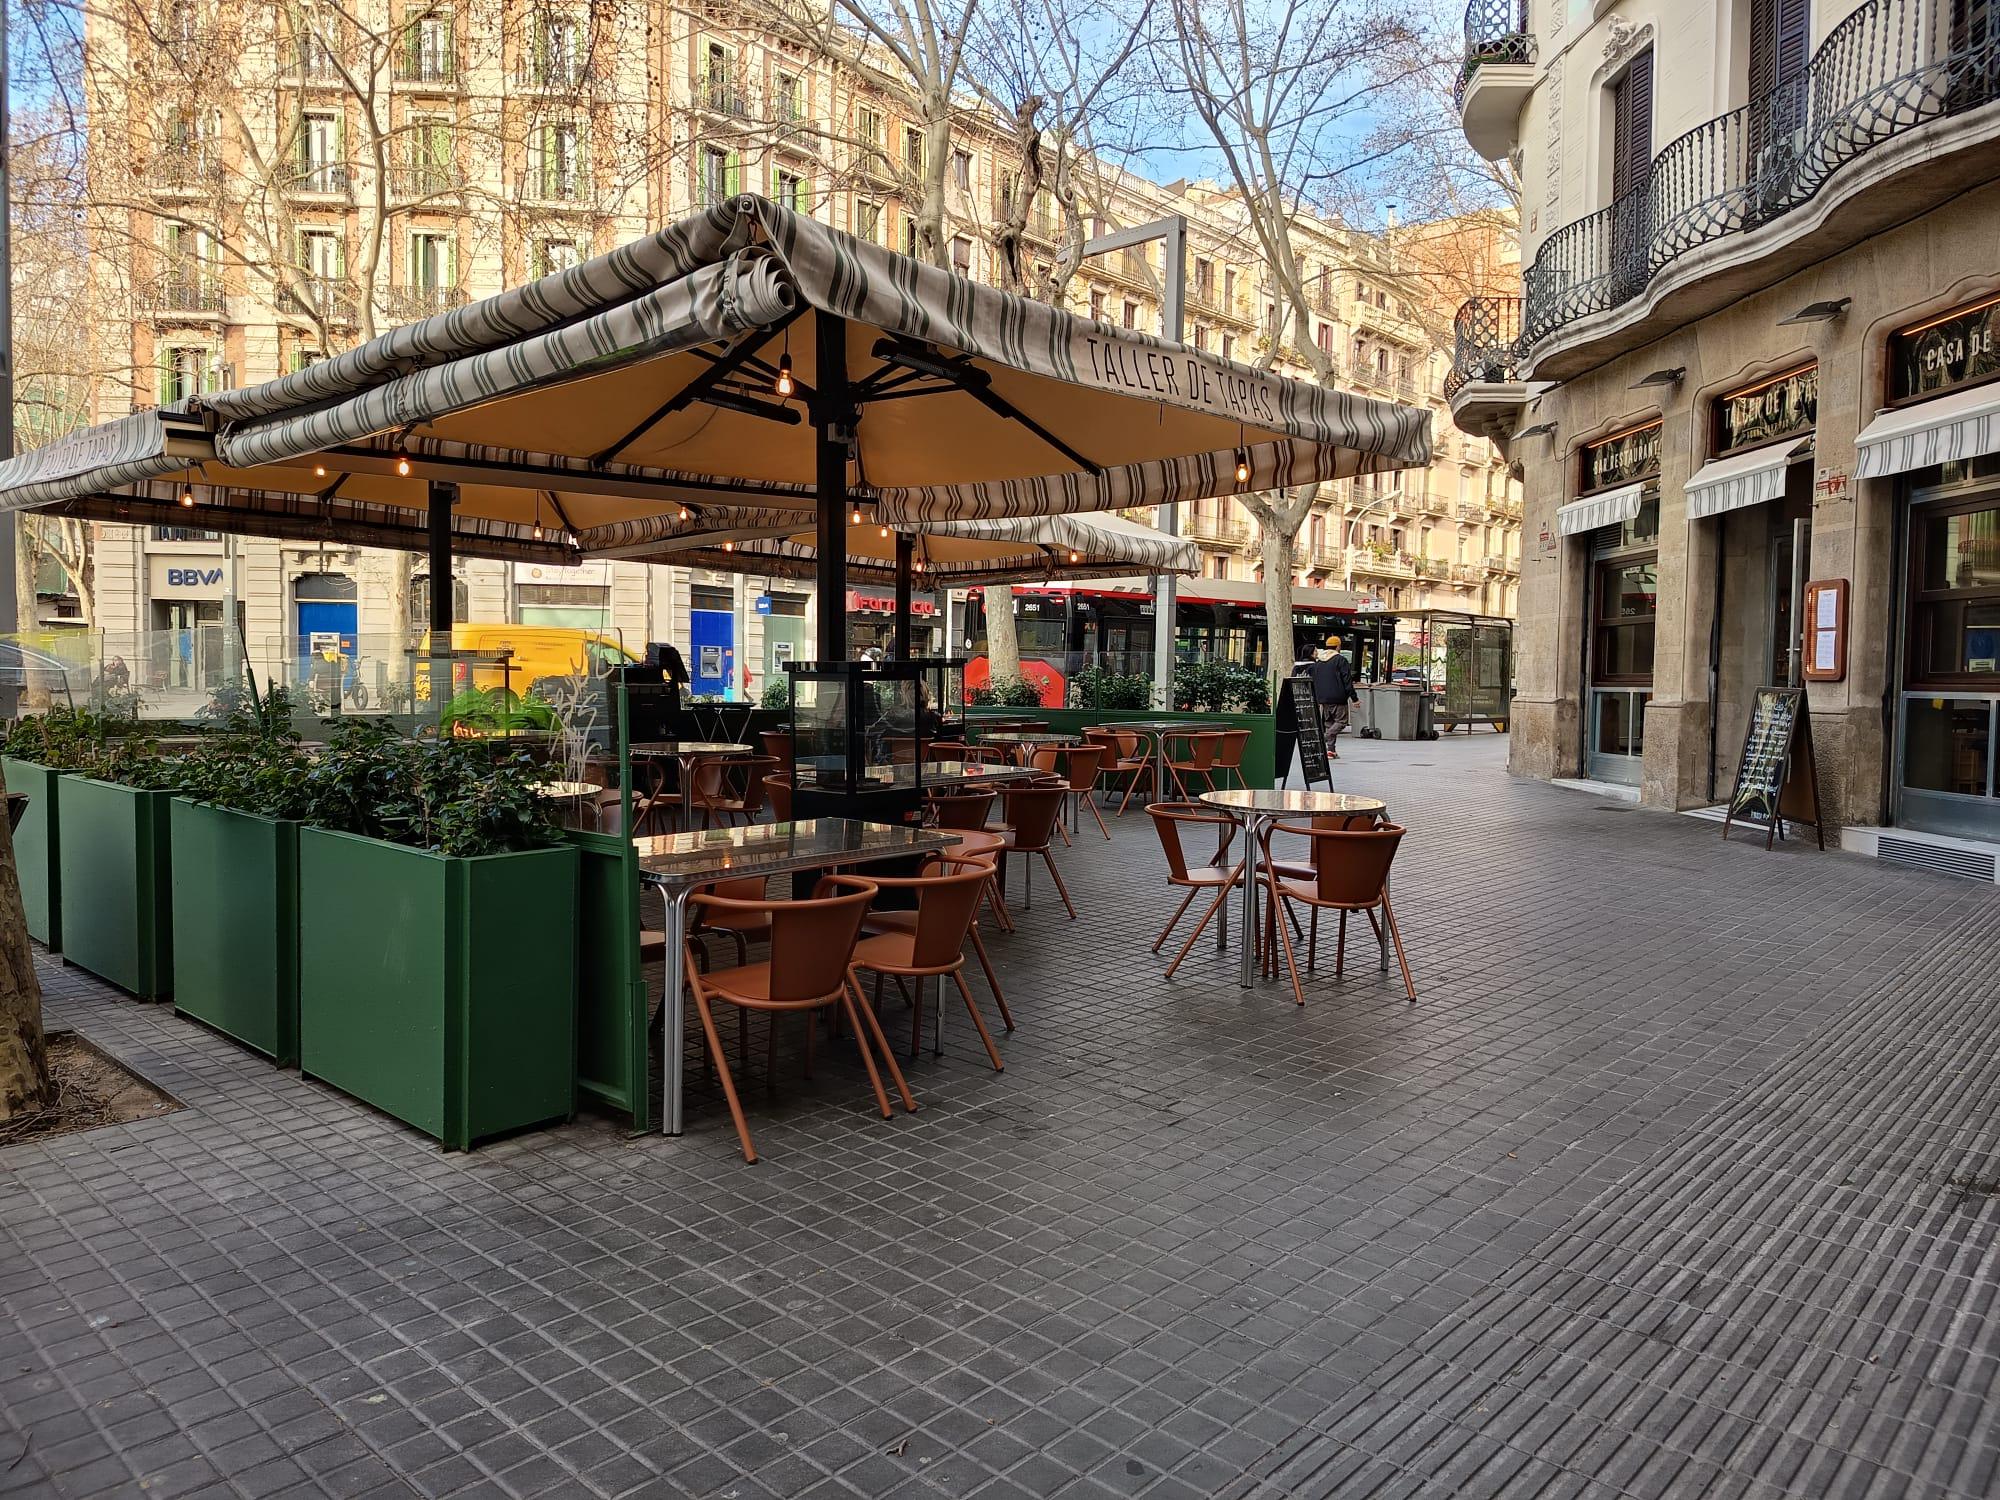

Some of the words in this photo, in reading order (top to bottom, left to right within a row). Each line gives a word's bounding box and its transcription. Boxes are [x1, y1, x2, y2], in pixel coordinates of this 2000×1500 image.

[1927, 339, 1964, 371] CASA
[1971, 330, 1992, 357] DE
[1087, 338, 1179, 396] TALLER
[1187, 360, 1212, 404] DE
[1216, 371, 1274, 422] TAPAS
[1025, 603, 1040, 612] 2651
